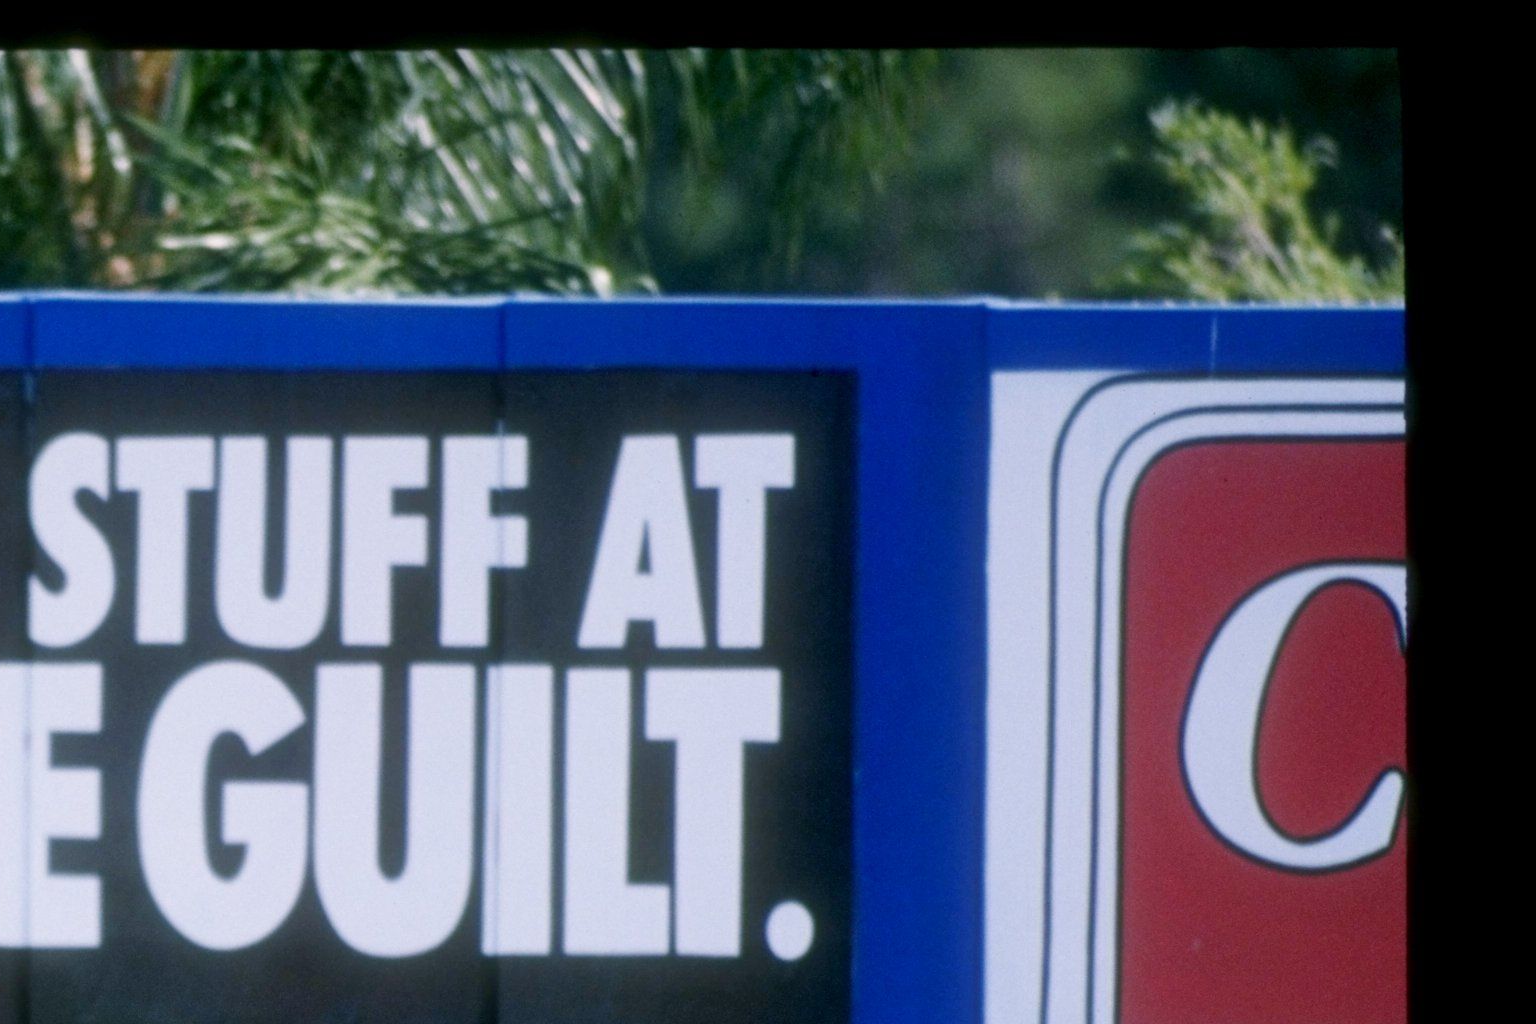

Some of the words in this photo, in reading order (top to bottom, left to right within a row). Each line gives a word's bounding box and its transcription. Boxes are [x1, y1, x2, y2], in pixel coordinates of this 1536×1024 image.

[27, 430, 530, 652] STUFF
[576, 432, 797, 650] AT
[134, 658, 815, 961] GUILT.
